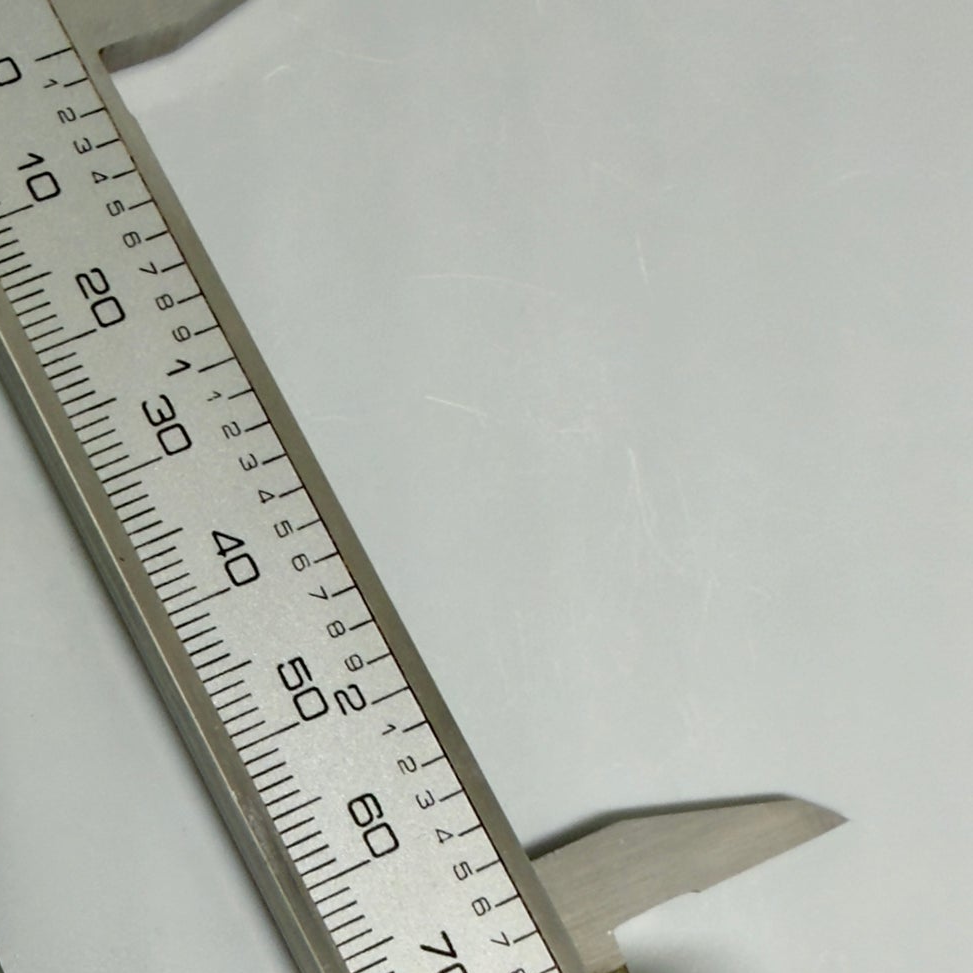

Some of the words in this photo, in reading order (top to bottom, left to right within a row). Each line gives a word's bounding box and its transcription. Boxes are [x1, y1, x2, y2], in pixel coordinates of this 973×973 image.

[43, 78, 59, 89] 1
[57, 106, 77, 124] 2
[73, 137, 93, 155] 3
[90, 170, 109, 184] 4
[106, 199, 125, 217] 5
[122, 231, 142, 248] 6
[139, 261, 158, 276] 7
[155, 293, 174, 311] 8
[172, 325, 191, 343] 9
[166, 359, 192, 377] 1
[206, 391, 223, 402] 1
[221, 421, 242, 439] 2
[238, 453, 258, 471] 3
[258, 488, 276, 504] 4
[17, 152, 62, 202] 10
[75, 267, 126, 328] 20
[141, 394, 193, 456] 30
[211, 530, 261, 587] 40
[276, 656, 330, 722] 50
[347, 793, 400, 859] 60
[273, 520, 294, 538] 5
[291, 553, 311, 572] 6
[308, 586, 329, 601] 7
[326, 620, 346, 638] 8
[344, 653, 364, 672] 9
[333, 683, 367, 716] 2
[381, 723, 397, 736] 1
[397, 755, 417, 775] 2
[415, 790, 435, 810] 3
[435, 828, 454, 845] 4
[453, 861, 473, 881] 5
[471, 897, 492, 917] 6
[490, 931, 511, 947] 7
